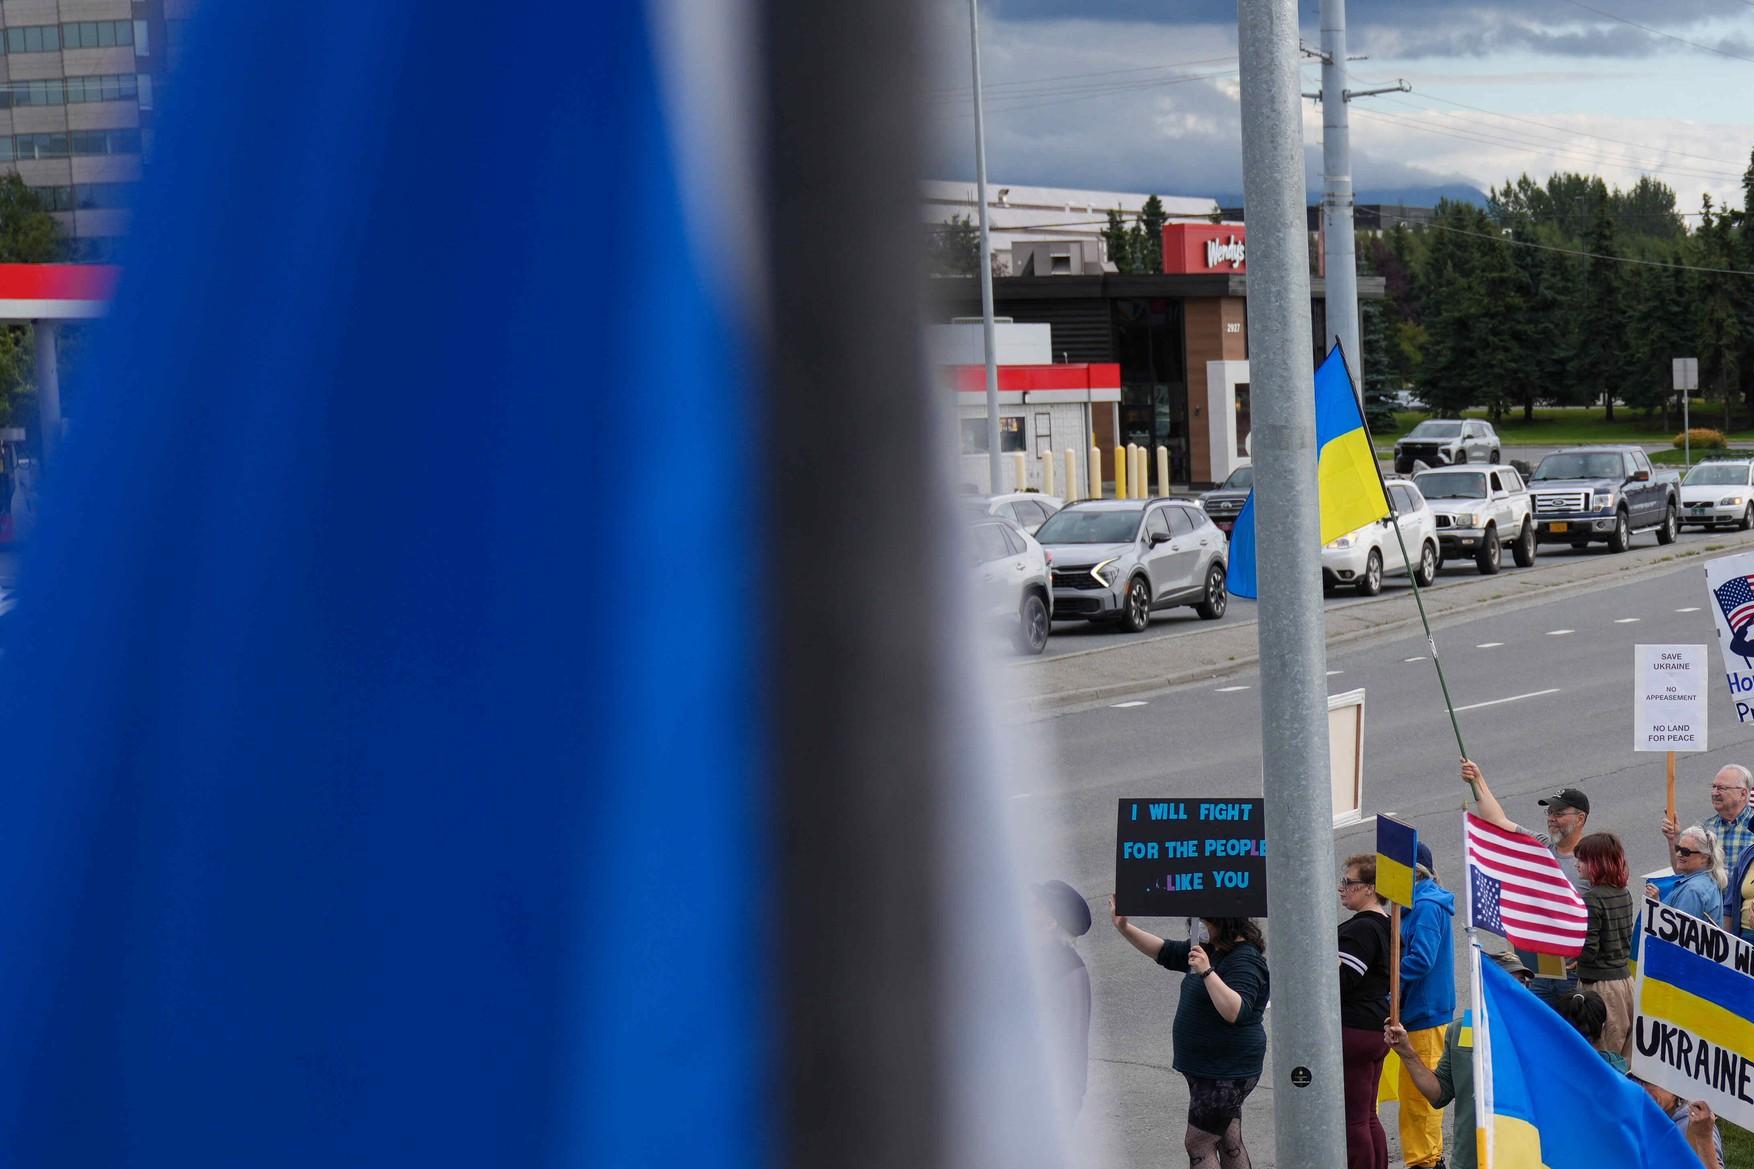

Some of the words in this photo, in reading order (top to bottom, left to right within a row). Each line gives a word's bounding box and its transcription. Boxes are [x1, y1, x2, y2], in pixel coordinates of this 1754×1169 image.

[1207, 234, 1245, 269] Wendy's
[1653, 662, 1690, 670] UKRAINE
[1661, 653, 1682, 661] SAVE
[1668, 724, 1690, 732] LAND
[1648, 734, 1666, 742] FOR
[1668, 734, 1695, 742] PEACE
[1131, 804, 1137, 821] I
[1150, 803, 1188, 821] WILL
[1200, 803, 1252, 821] FIGHT
[1124, 841, 1158, 860] FOR
[1165, 840, 1198, 858] THE
[1204, 838, 1267, 858] PEOPLE
[1166, 872, 1203, 892] LIKE
[1212, 870, 1250, 888] YOU
[1644, 898, 1660, 937] I
[1659, 908, 1730, 963] STAND
